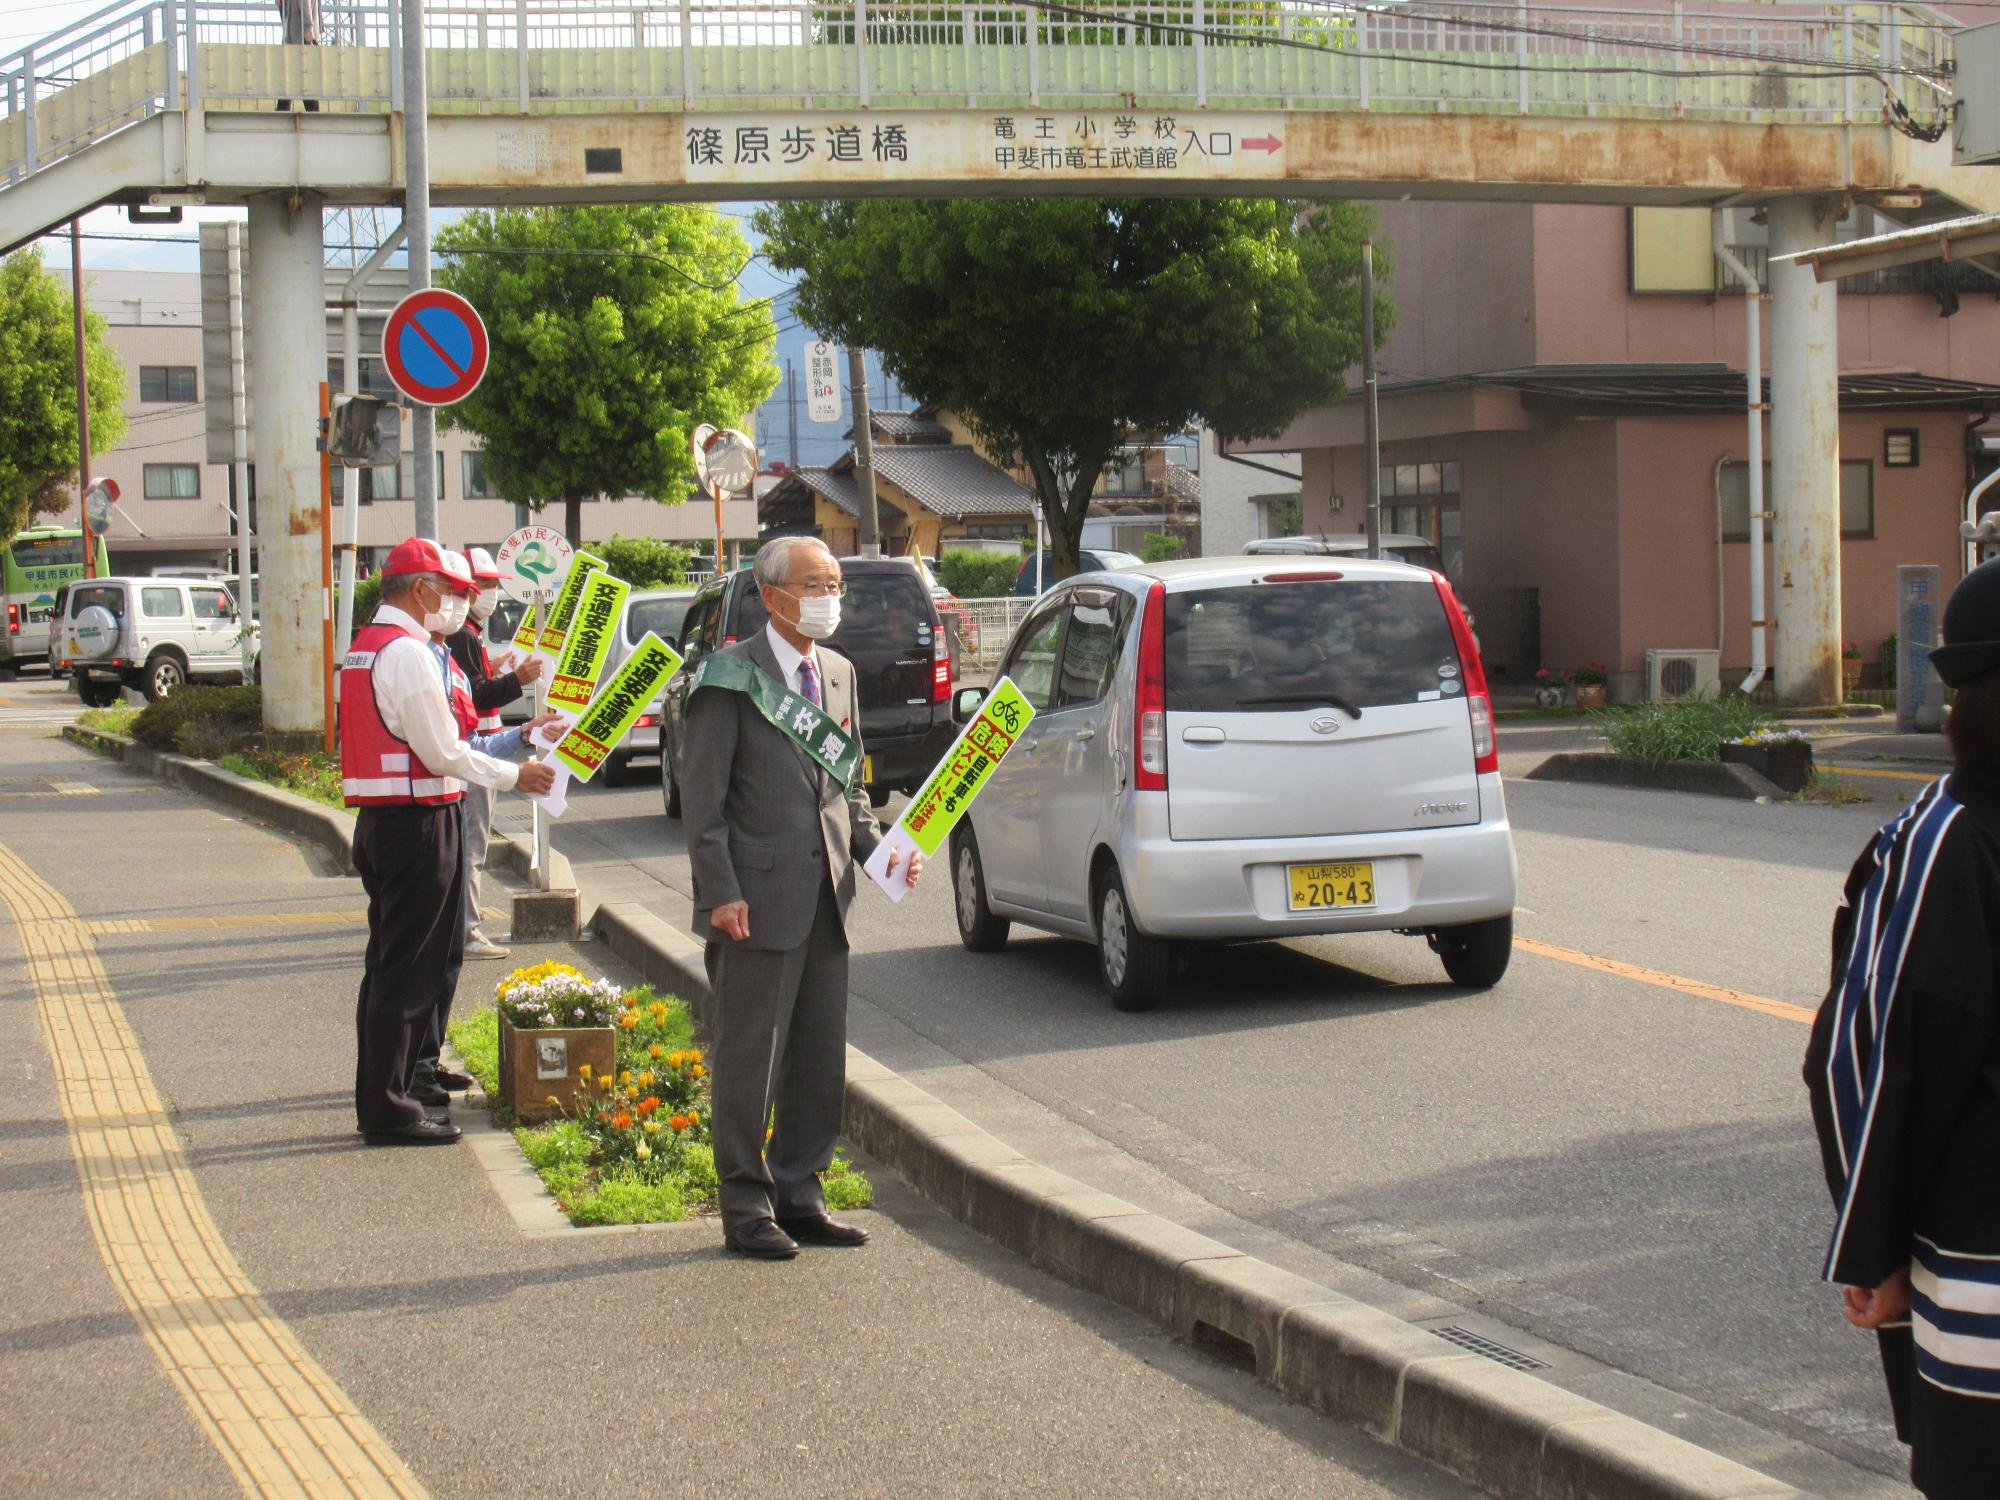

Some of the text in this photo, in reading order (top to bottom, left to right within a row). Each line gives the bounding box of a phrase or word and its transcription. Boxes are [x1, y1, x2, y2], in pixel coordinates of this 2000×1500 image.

[994, 116, 1177, 140] 竜王小学校
[1182, 130, 1232, 156] 入口
[686, 124, 908, 165] 篠原歩道橋
[995, 146, 1177, 170] 甲斐市竜王武道館
[812, 357, 824, 398] 整形外科
[822, 357, 833, 379] 赤岡
[499, 527, 571, 561] 甲斐市民バス
[566, 582, 619, 678] 交通安全運動
[548, 680, 593, 700] 実施中
[584, 647, 672, 742] 交通安全運動
[775, 695, 794, 721] 甲斐市
[559, 734, 607, 764] 実施中
[793, 706, 846, 767] 交通
[969, 720, 1009, 760] 危険
[909, 745, 977, 832] スピード注意
[945, 755, 990, 813] 自転車も
[1294, 890, 1305, 901] ぬ
[1308, 881, 1373, 907] 20-43
